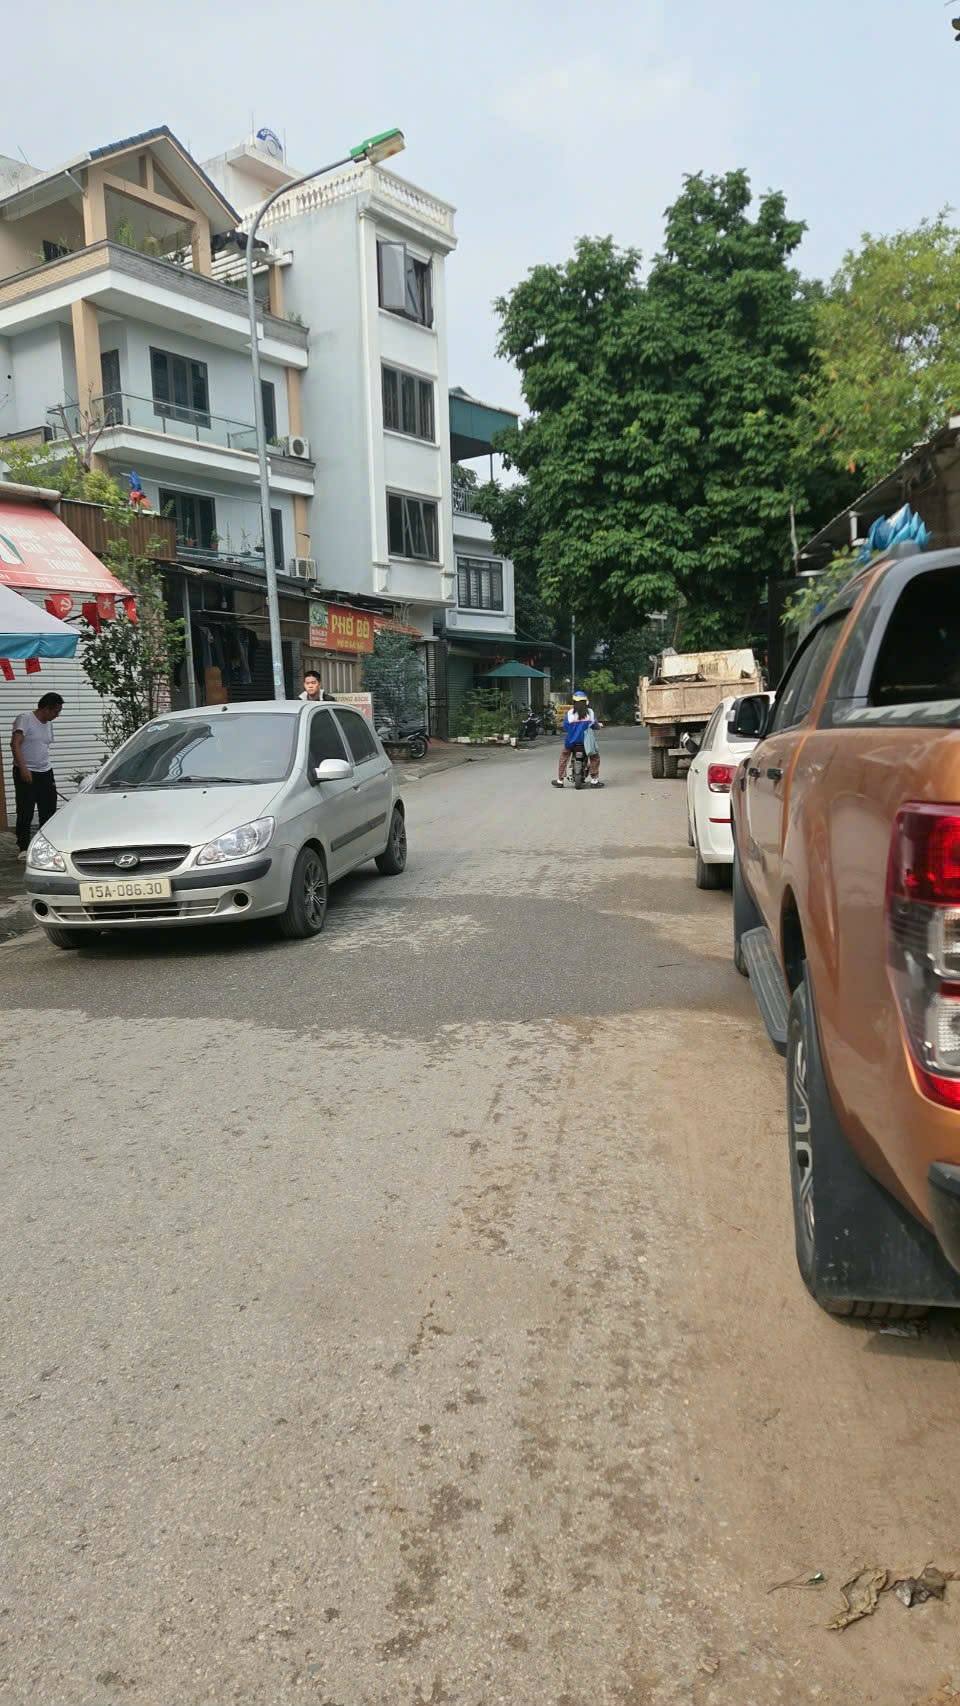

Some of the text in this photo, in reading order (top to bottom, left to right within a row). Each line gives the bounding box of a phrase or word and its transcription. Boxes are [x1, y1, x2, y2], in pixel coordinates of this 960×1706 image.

[332, 613, 369, 639] PHỞ BÒ
[88, 882, 162, 898] 15A-086.30
